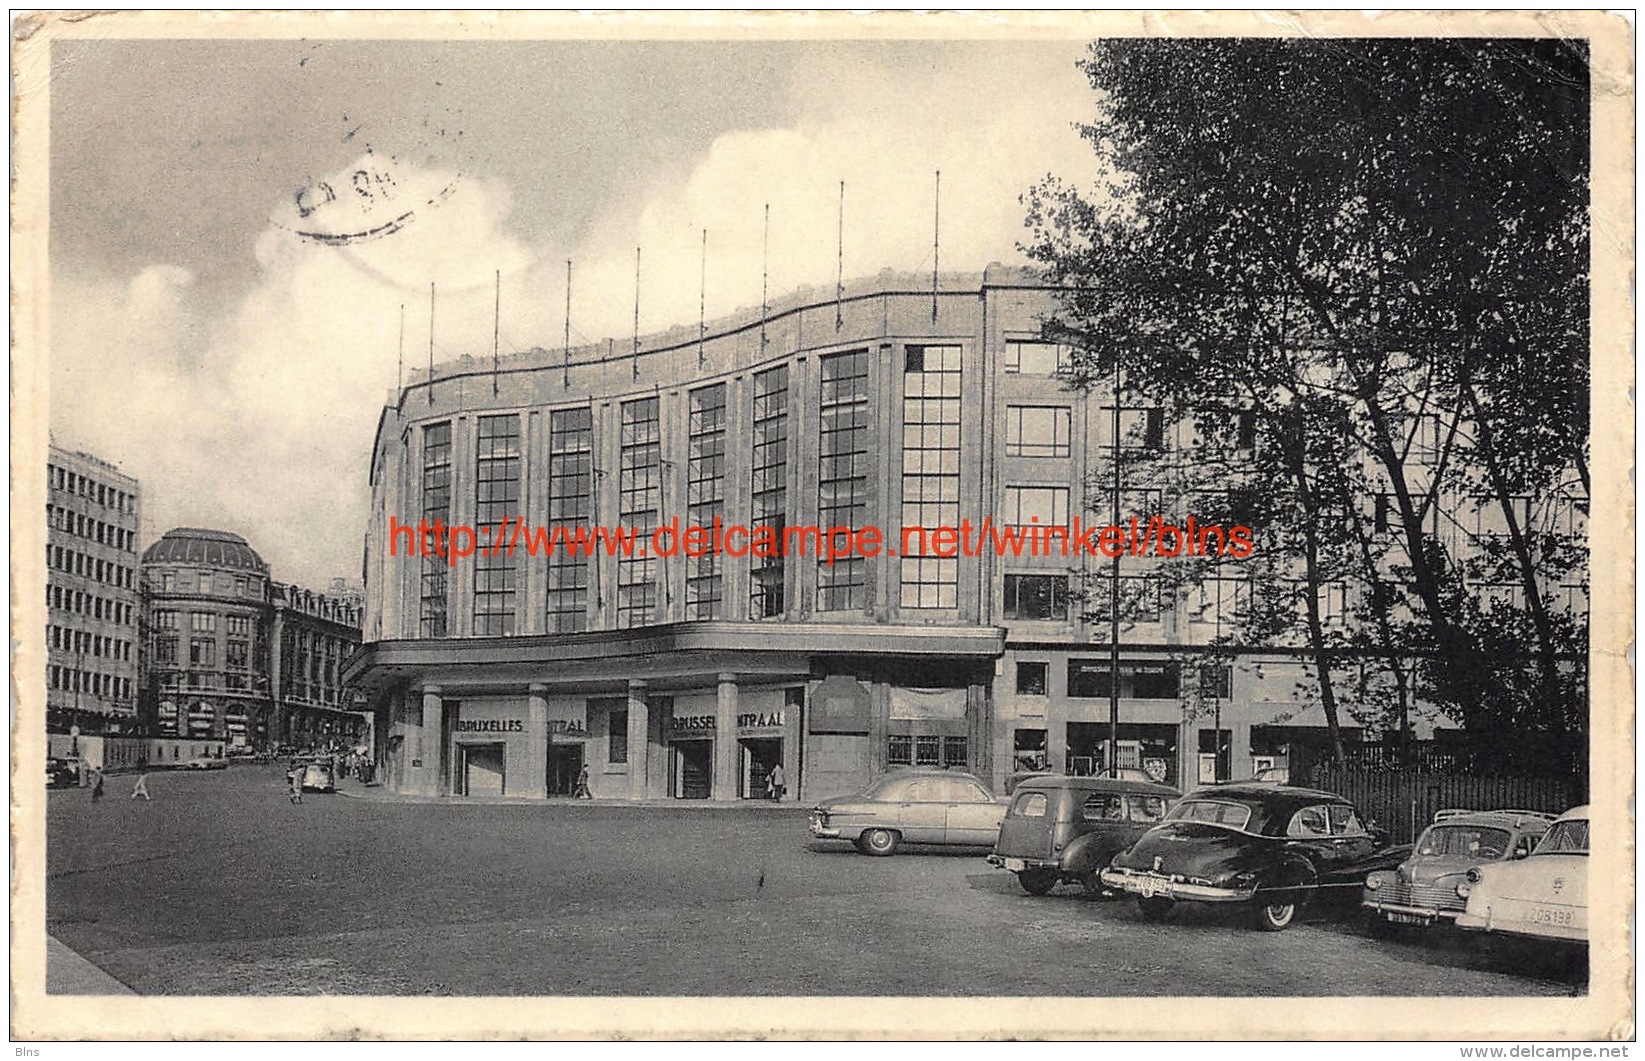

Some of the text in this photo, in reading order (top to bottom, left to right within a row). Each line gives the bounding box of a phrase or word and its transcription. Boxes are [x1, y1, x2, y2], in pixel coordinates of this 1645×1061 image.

[456, 719, 584, 733] BRUXELLES TRAL
[672, 712, 783, 730] BRUSSEL NTRAAL
